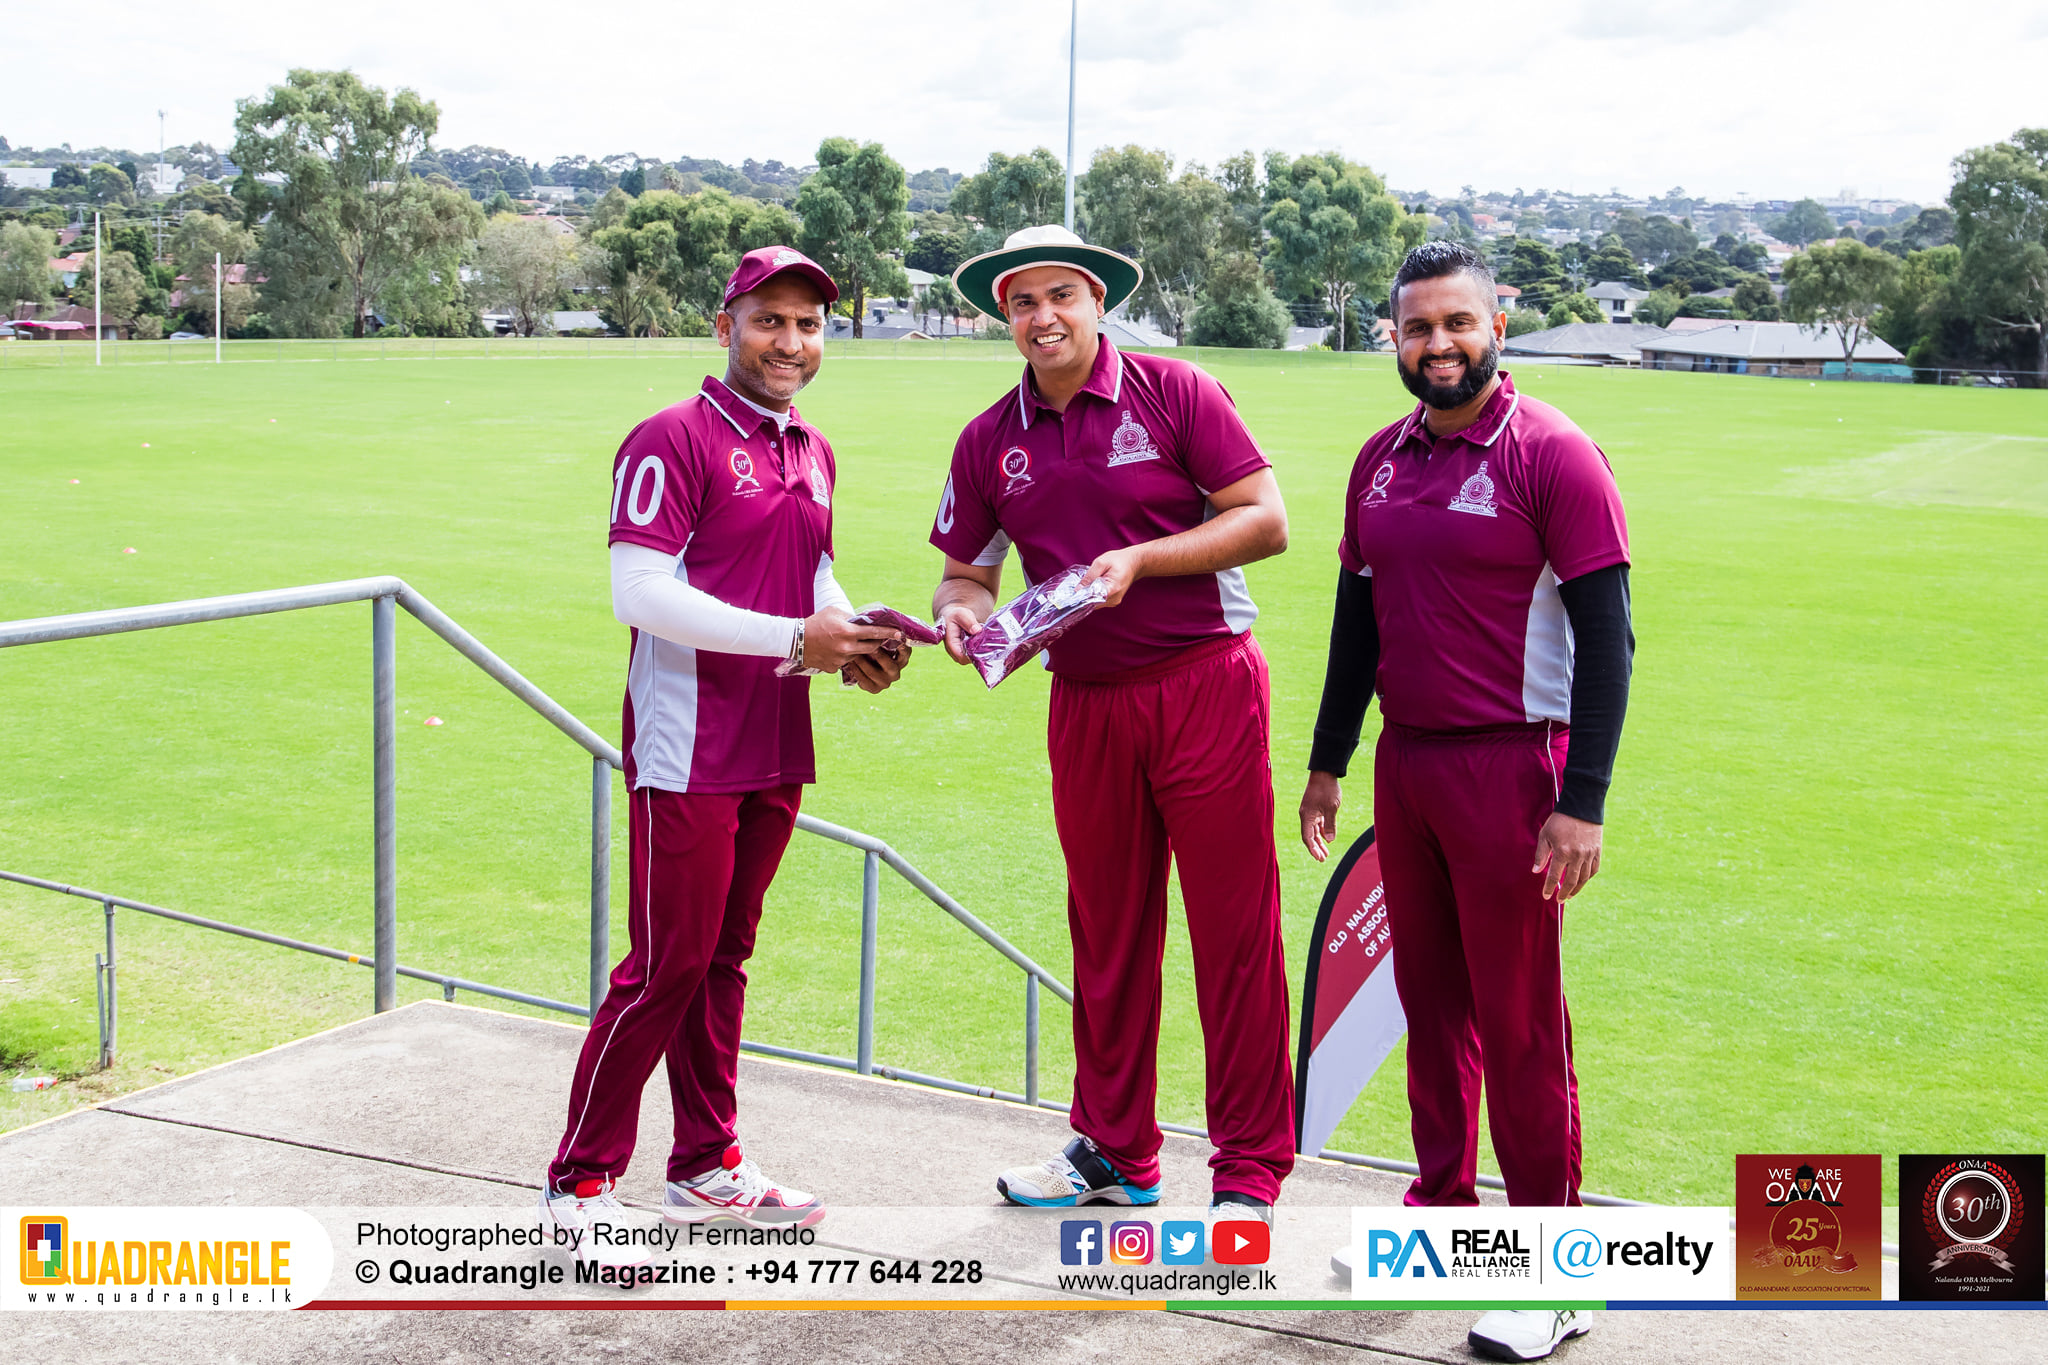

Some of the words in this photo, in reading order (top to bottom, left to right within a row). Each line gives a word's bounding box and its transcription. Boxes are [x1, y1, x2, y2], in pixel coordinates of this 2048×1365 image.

[611, 455, 666, 526] 10
[1328, 930, 1348, 953] OLD
[1345, 880, 1385, 931] NALANDI
[1364, 939, 1379, 958] OF
[1376, 922, 1391, 945] AU
